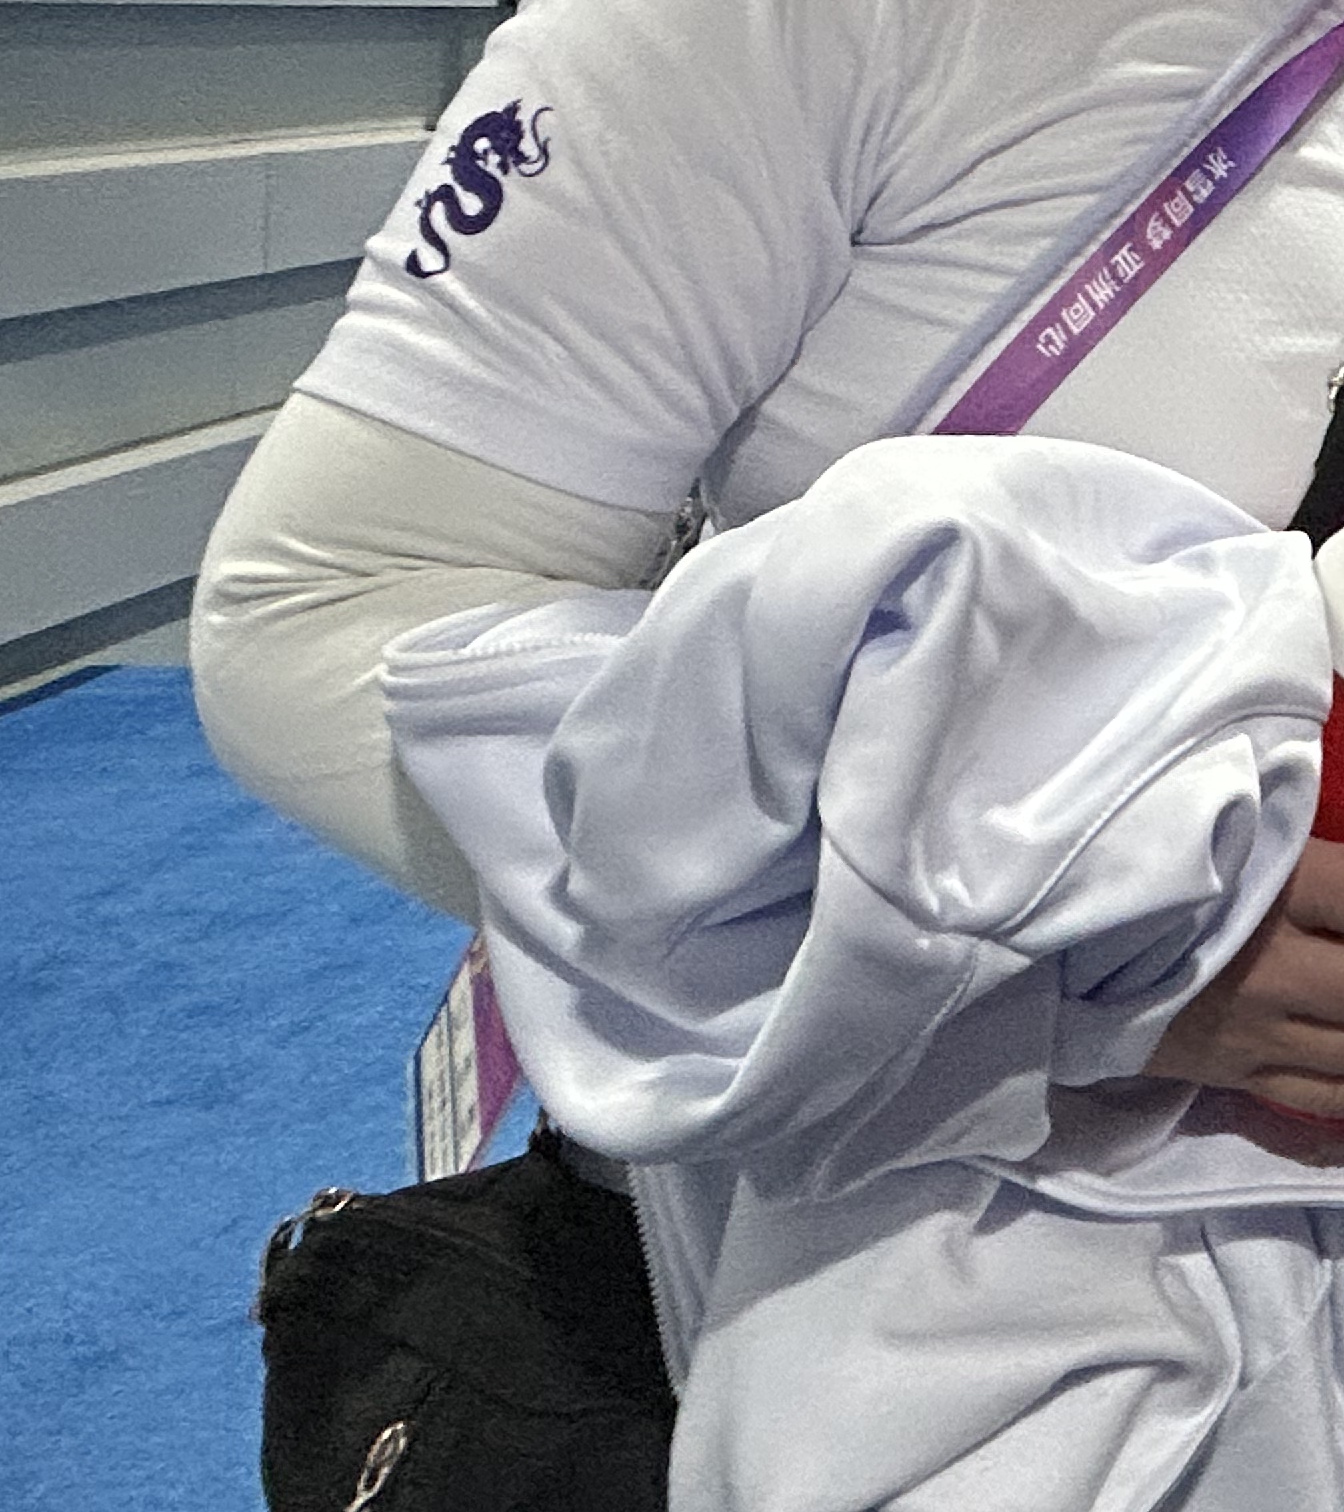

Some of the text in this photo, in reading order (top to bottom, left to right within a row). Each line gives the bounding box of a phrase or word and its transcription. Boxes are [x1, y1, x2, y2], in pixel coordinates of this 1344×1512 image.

[1035, 145, 1236, 360] 冰雪同梦 亚洲同心
